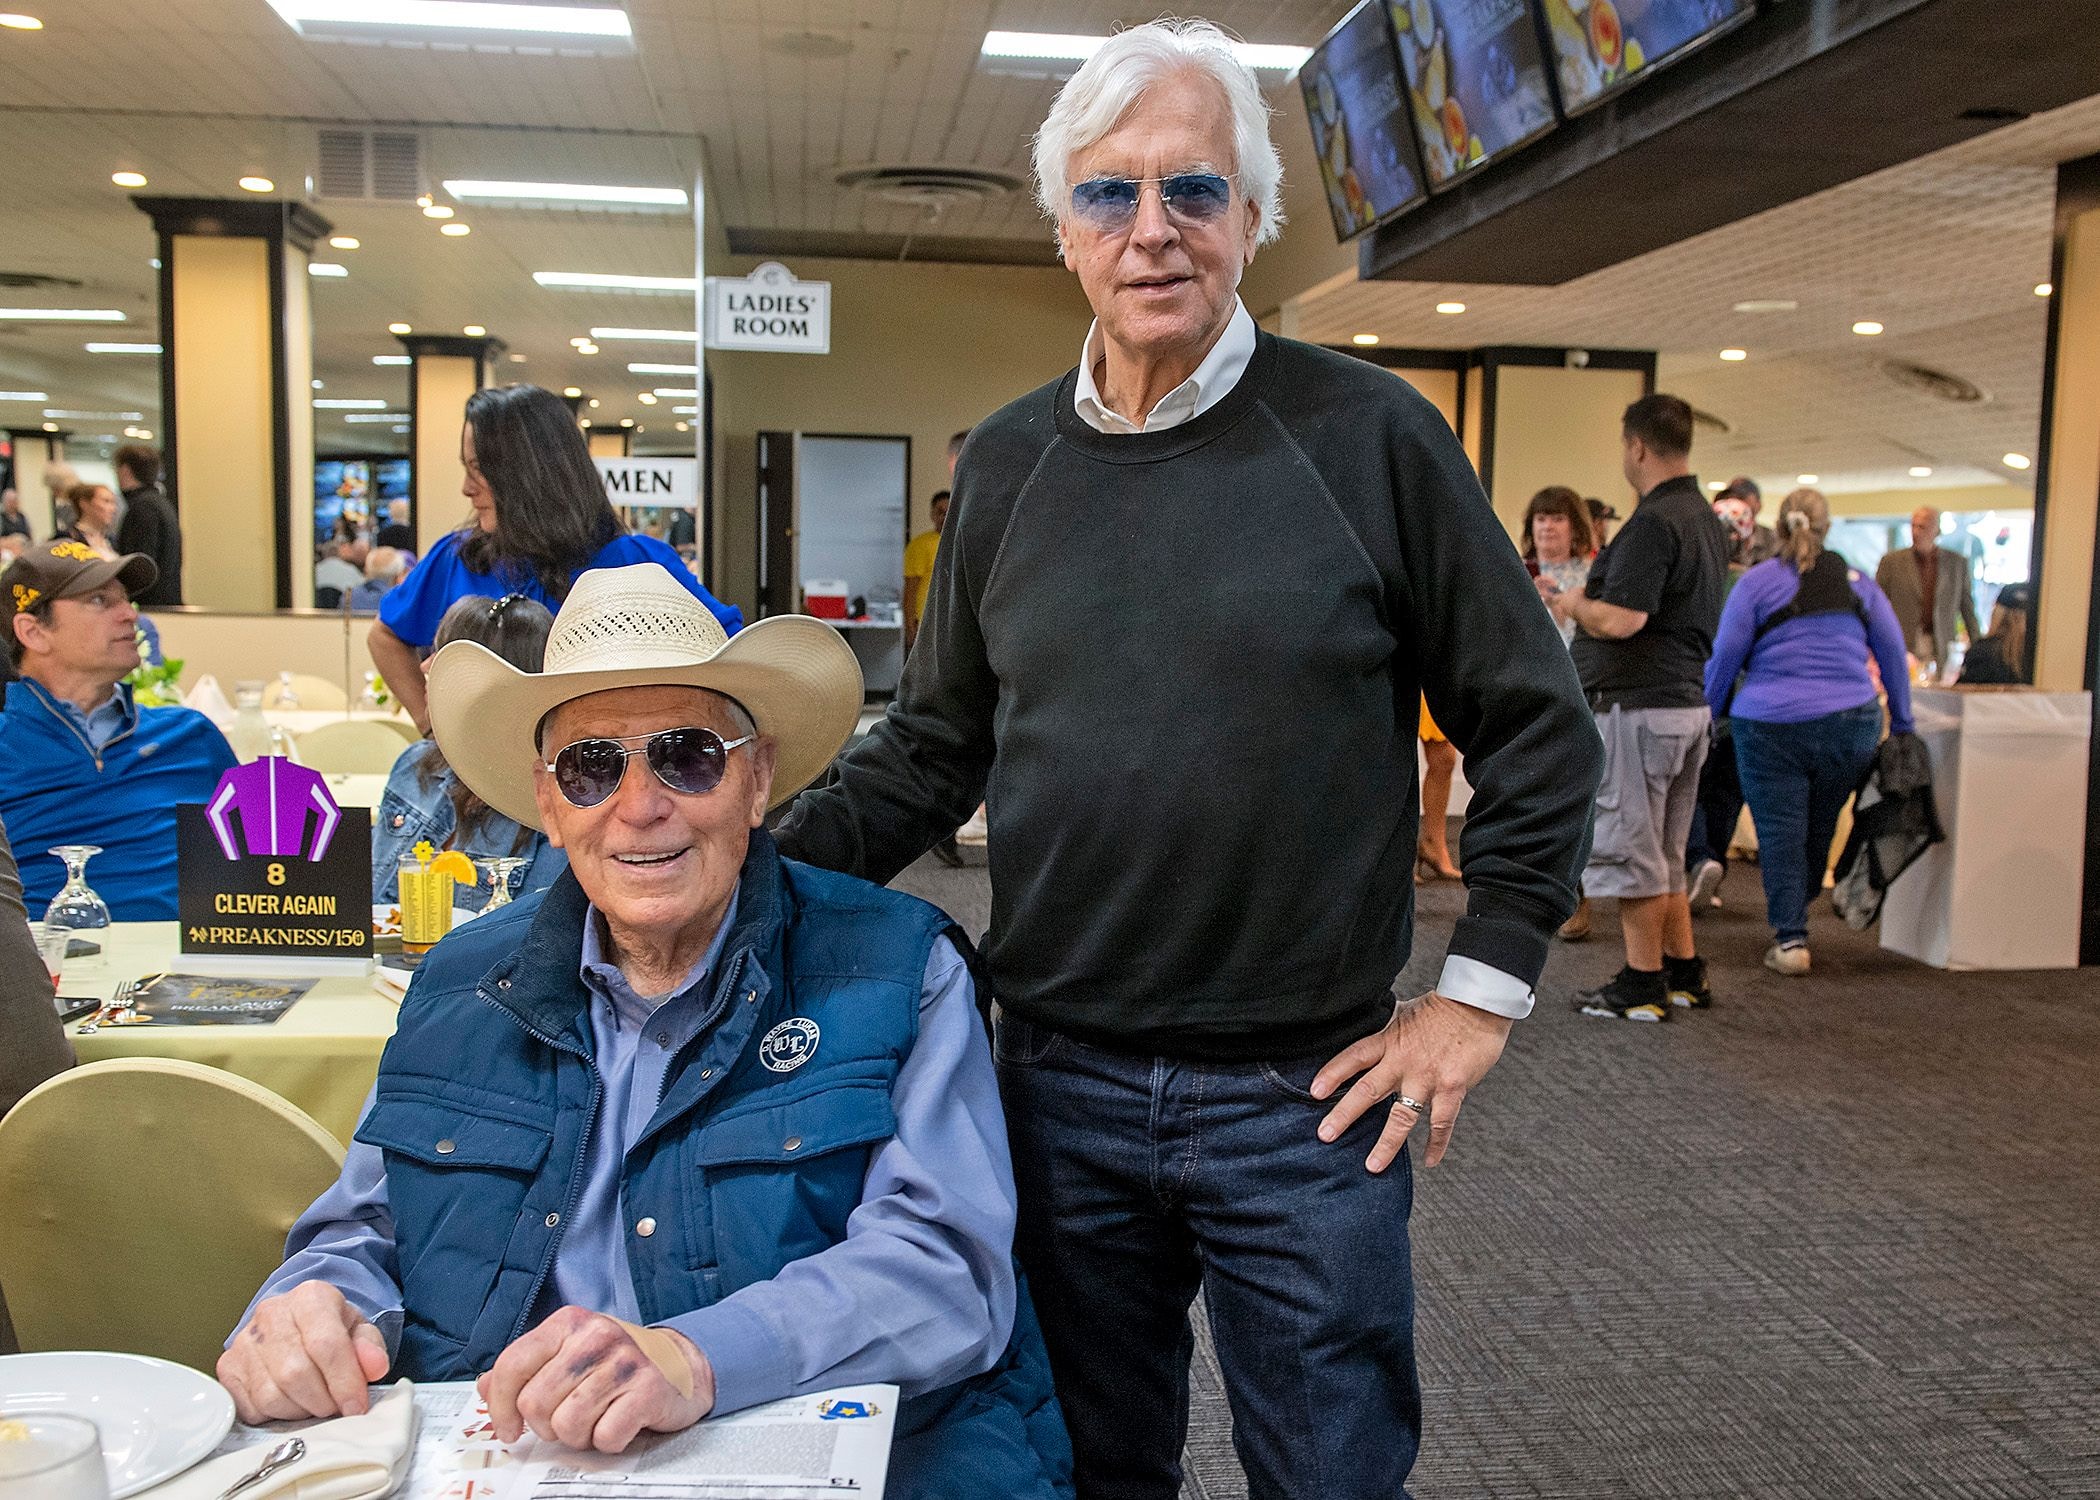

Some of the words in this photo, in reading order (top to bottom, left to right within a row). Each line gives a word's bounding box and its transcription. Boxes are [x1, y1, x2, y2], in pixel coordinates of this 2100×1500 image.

[728, 294, 816, 314] LADIES'
[734, 316, 808, 337] ROOM
[605, 469, 673, 493] MEN
[266, 862, 286, 887] 8
[215, 893, 279, 915] CLEVER
[282, 894, 337, 916] AGAIN
[772, 1053, 808, 1070] RACING
